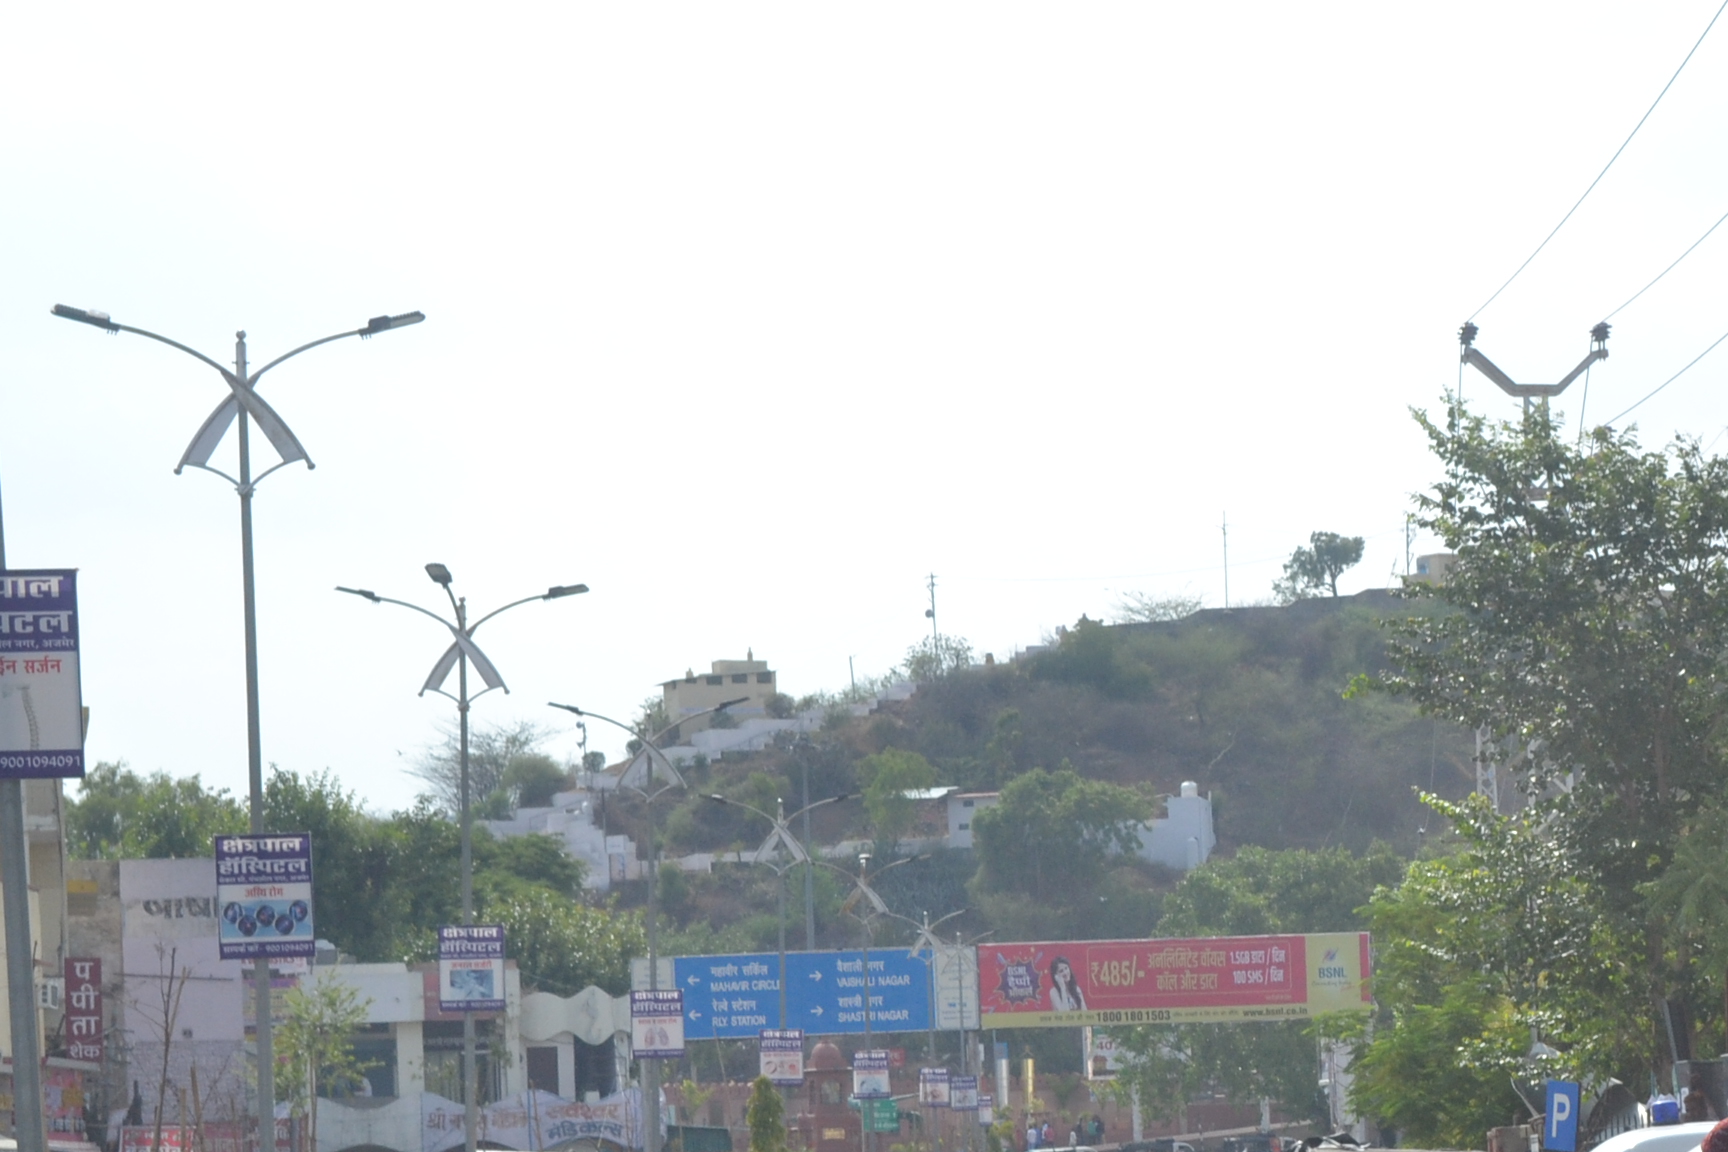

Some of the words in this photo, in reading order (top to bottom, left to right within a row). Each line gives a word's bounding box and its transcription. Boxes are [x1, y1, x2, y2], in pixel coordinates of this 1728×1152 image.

[24, 655, 62, 674] सर्जन
[222, 837, 302, 853] क्षेत्रपाल
[218, 857, 308, 875] हॉस्पिटल
[269, 886, 284, 896] रोग
[440, 940, 502, 952] हॉस्पिटल
[1148, 947, 1198, 969] अनलिमिटेड
[1230, 950, 1250, 965] 1.5GB
[1251, 949, 1265, 963] डाटा
[1272, 946, 1285, 964] दिन
[710, 963, 738, 977] महावीर
[741, 961, 769, 975] सर्किल
[836, 958, 863, 972] वैशाली
[1157, 972, 1177, 990] कॉल
[1180, 969, 1198, 990] और
[1200, 972, 1218, 990] डाटा
[1233, 969, 1246, 984] 100
[1247, 969, 1264, 984] SMS
[1270, 966, 1284, 983] दिन
[1318, 966, 1347, 979] BSNL
[710, 980, 750, 992] MAHAVIR
[878, 974, 910, 986] NAGAR
[731, 996, 756, 1011] स्टेशन
[837, 993, 862, 1007] शास्त्री
[838, 1010, 876, 1022] SHASTRI
[877, 1009, 909, 1021] NAGAR
[1097, 1011, 1122, 1022] 1800
[1125, 1010, 1142, 1021] 180
[1145, 1010, 1171, 1021] 1503
[1243, 1006, 1308, 1018] www.bsnl.co.in
[731, 1014, 766, 1026] STATION
[70, 1043, 100, 1060] शेक
[1551, 1092, 1571, 1138] P
